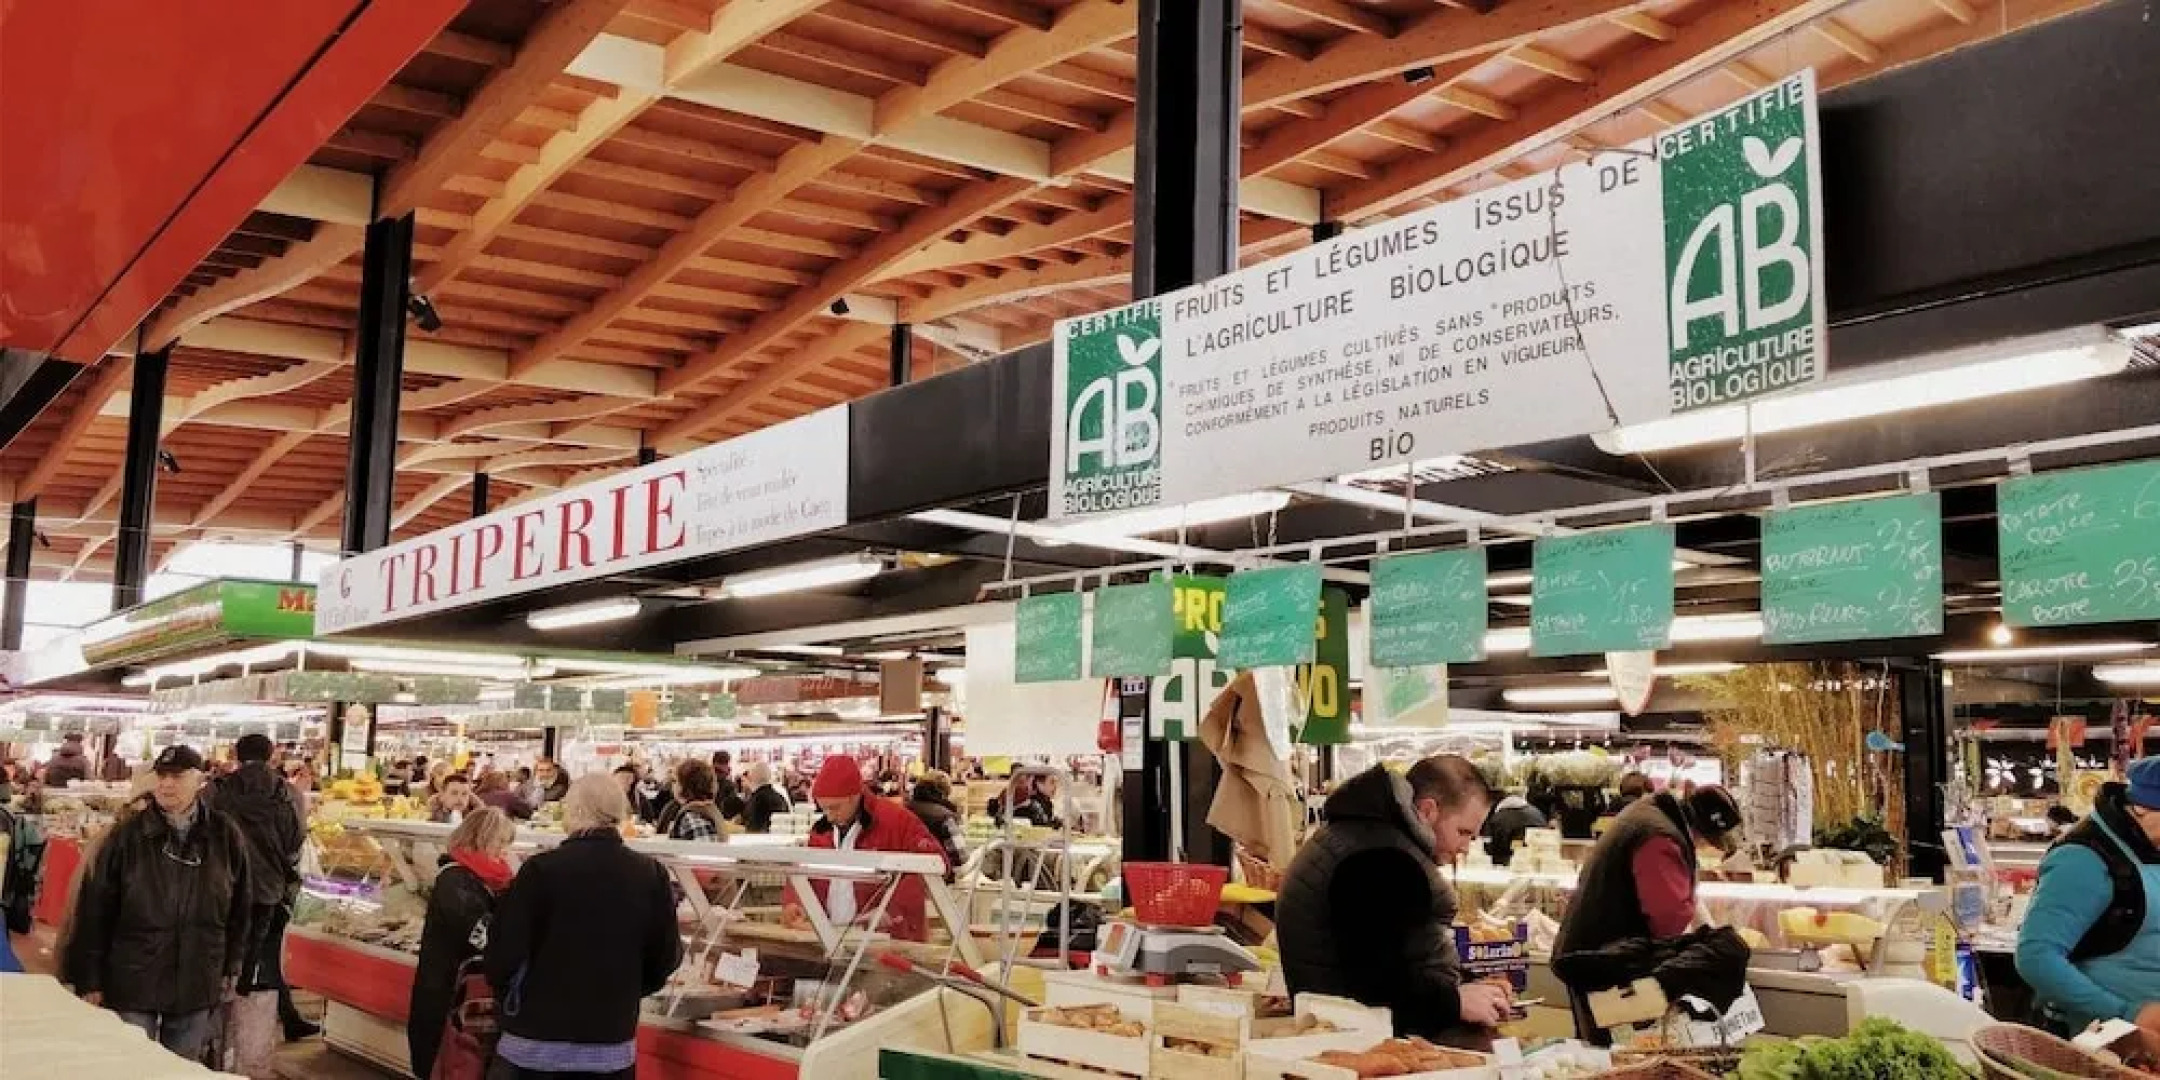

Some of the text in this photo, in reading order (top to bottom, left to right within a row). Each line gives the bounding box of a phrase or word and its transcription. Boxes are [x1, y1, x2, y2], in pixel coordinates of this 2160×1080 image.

[1267, 268, 1292, 294] ET
[1600, 157, 1639, 193] DE
[1671, 182, 1809, 349] AB
[1233, 368, 1249, 385] ET
[1436, 311, 1484, 335] SANS
[1267, 381, 1284, 398] DE
[1419, 343, 1441, 361] DE
[1314, 392, 1332, 407] LA
[1464, 356, 1488, 375] EN
[1671, 324, 1814, 384] AGRICULTURE
[1671, 352, 1814, 410] BIOLOGIQUE
[1068, 366, 1160, 474] AB
[1309, 389, 1489, 437] PRODUITS NATURELS
[380, 470, 686, 613] TRIPERIE
